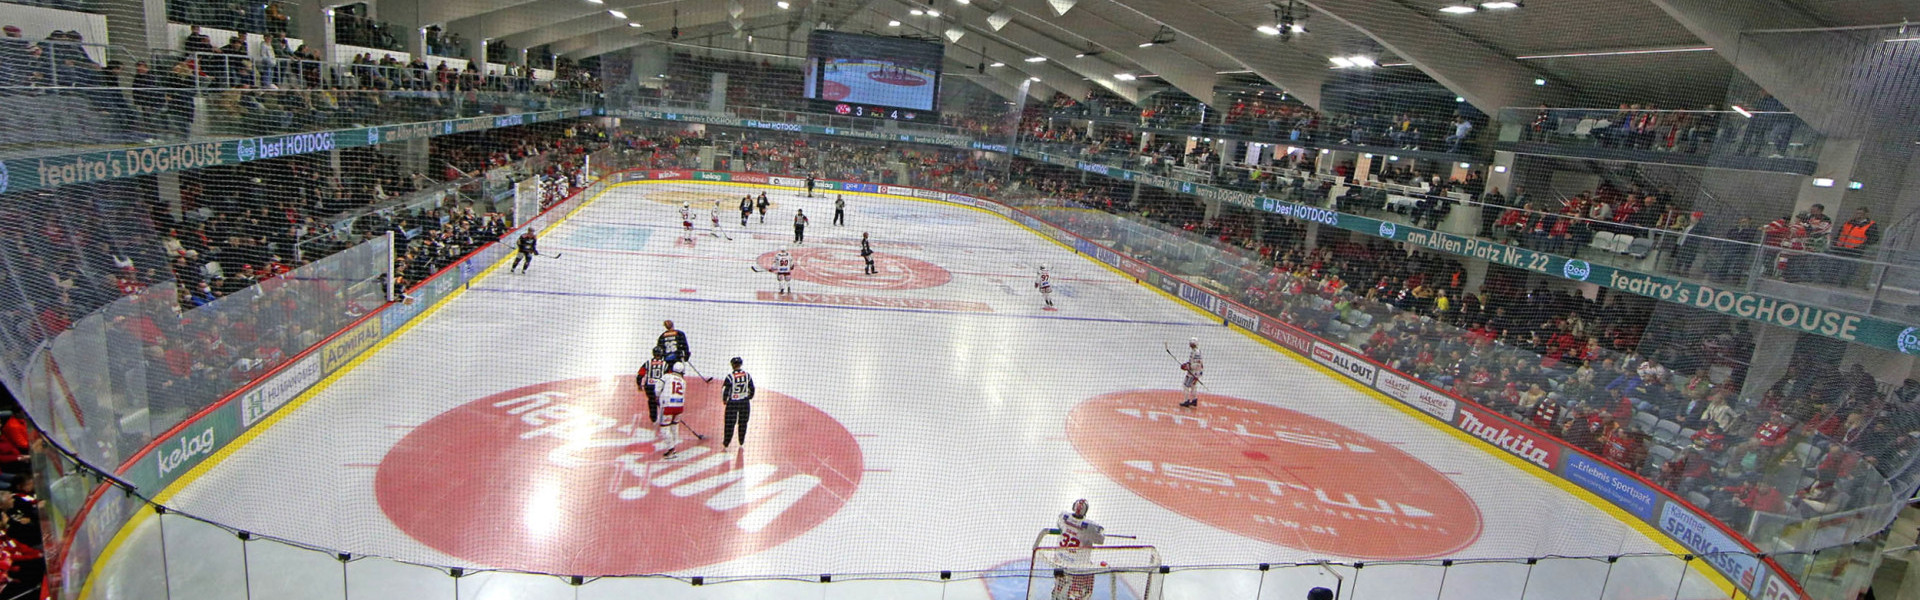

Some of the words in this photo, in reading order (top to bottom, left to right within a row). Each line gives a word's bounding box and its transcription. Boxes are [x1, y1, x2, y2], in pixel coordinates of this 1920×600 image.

[856, 106, 863, 116] 3
[890, 110, 898, 119] 4
[127, 142, 223, 175] DOGHOUSE
[259, 137, 283, 158] best
[286, 132, 336, 155] HOTDOGS
[1217, 188, 1256, 208] DOGHOUSE
[1275, 200, 1293, 215] best
[1293, 204, 1338, 226] HOTDOGS
[1407, 231, 1426, 245] am
[1428, 230, 1462, 252] Alten
[1464, 237, 1500, 262] Platz
[1503, 246, 1524, 268] Nr.
[1529, 253, 1550, 273] 22
[1610, 269, 1690, 304] teatro's
[1695, 285, 1862, 342] DOGHOUSE
[1226, 310, 1255, 330] Baumit
[325, 321, 378, 367] ADMIRAL
[1271, 326, 1311, 354] GENERALI
[1333, 355, 1350, 371] ALL
[1350, 363, 1373, 381] OUT.
[671, 381, 683, 395] 12
[734, 383, 748, 393] 57
[156, 426, 215, 478] kelag
[1611, 476, 1652, 505] Sportpark
[1670, 504, 1706, 534] Kärntner
[1665, 517, 1743, 580] SPARKASSE
